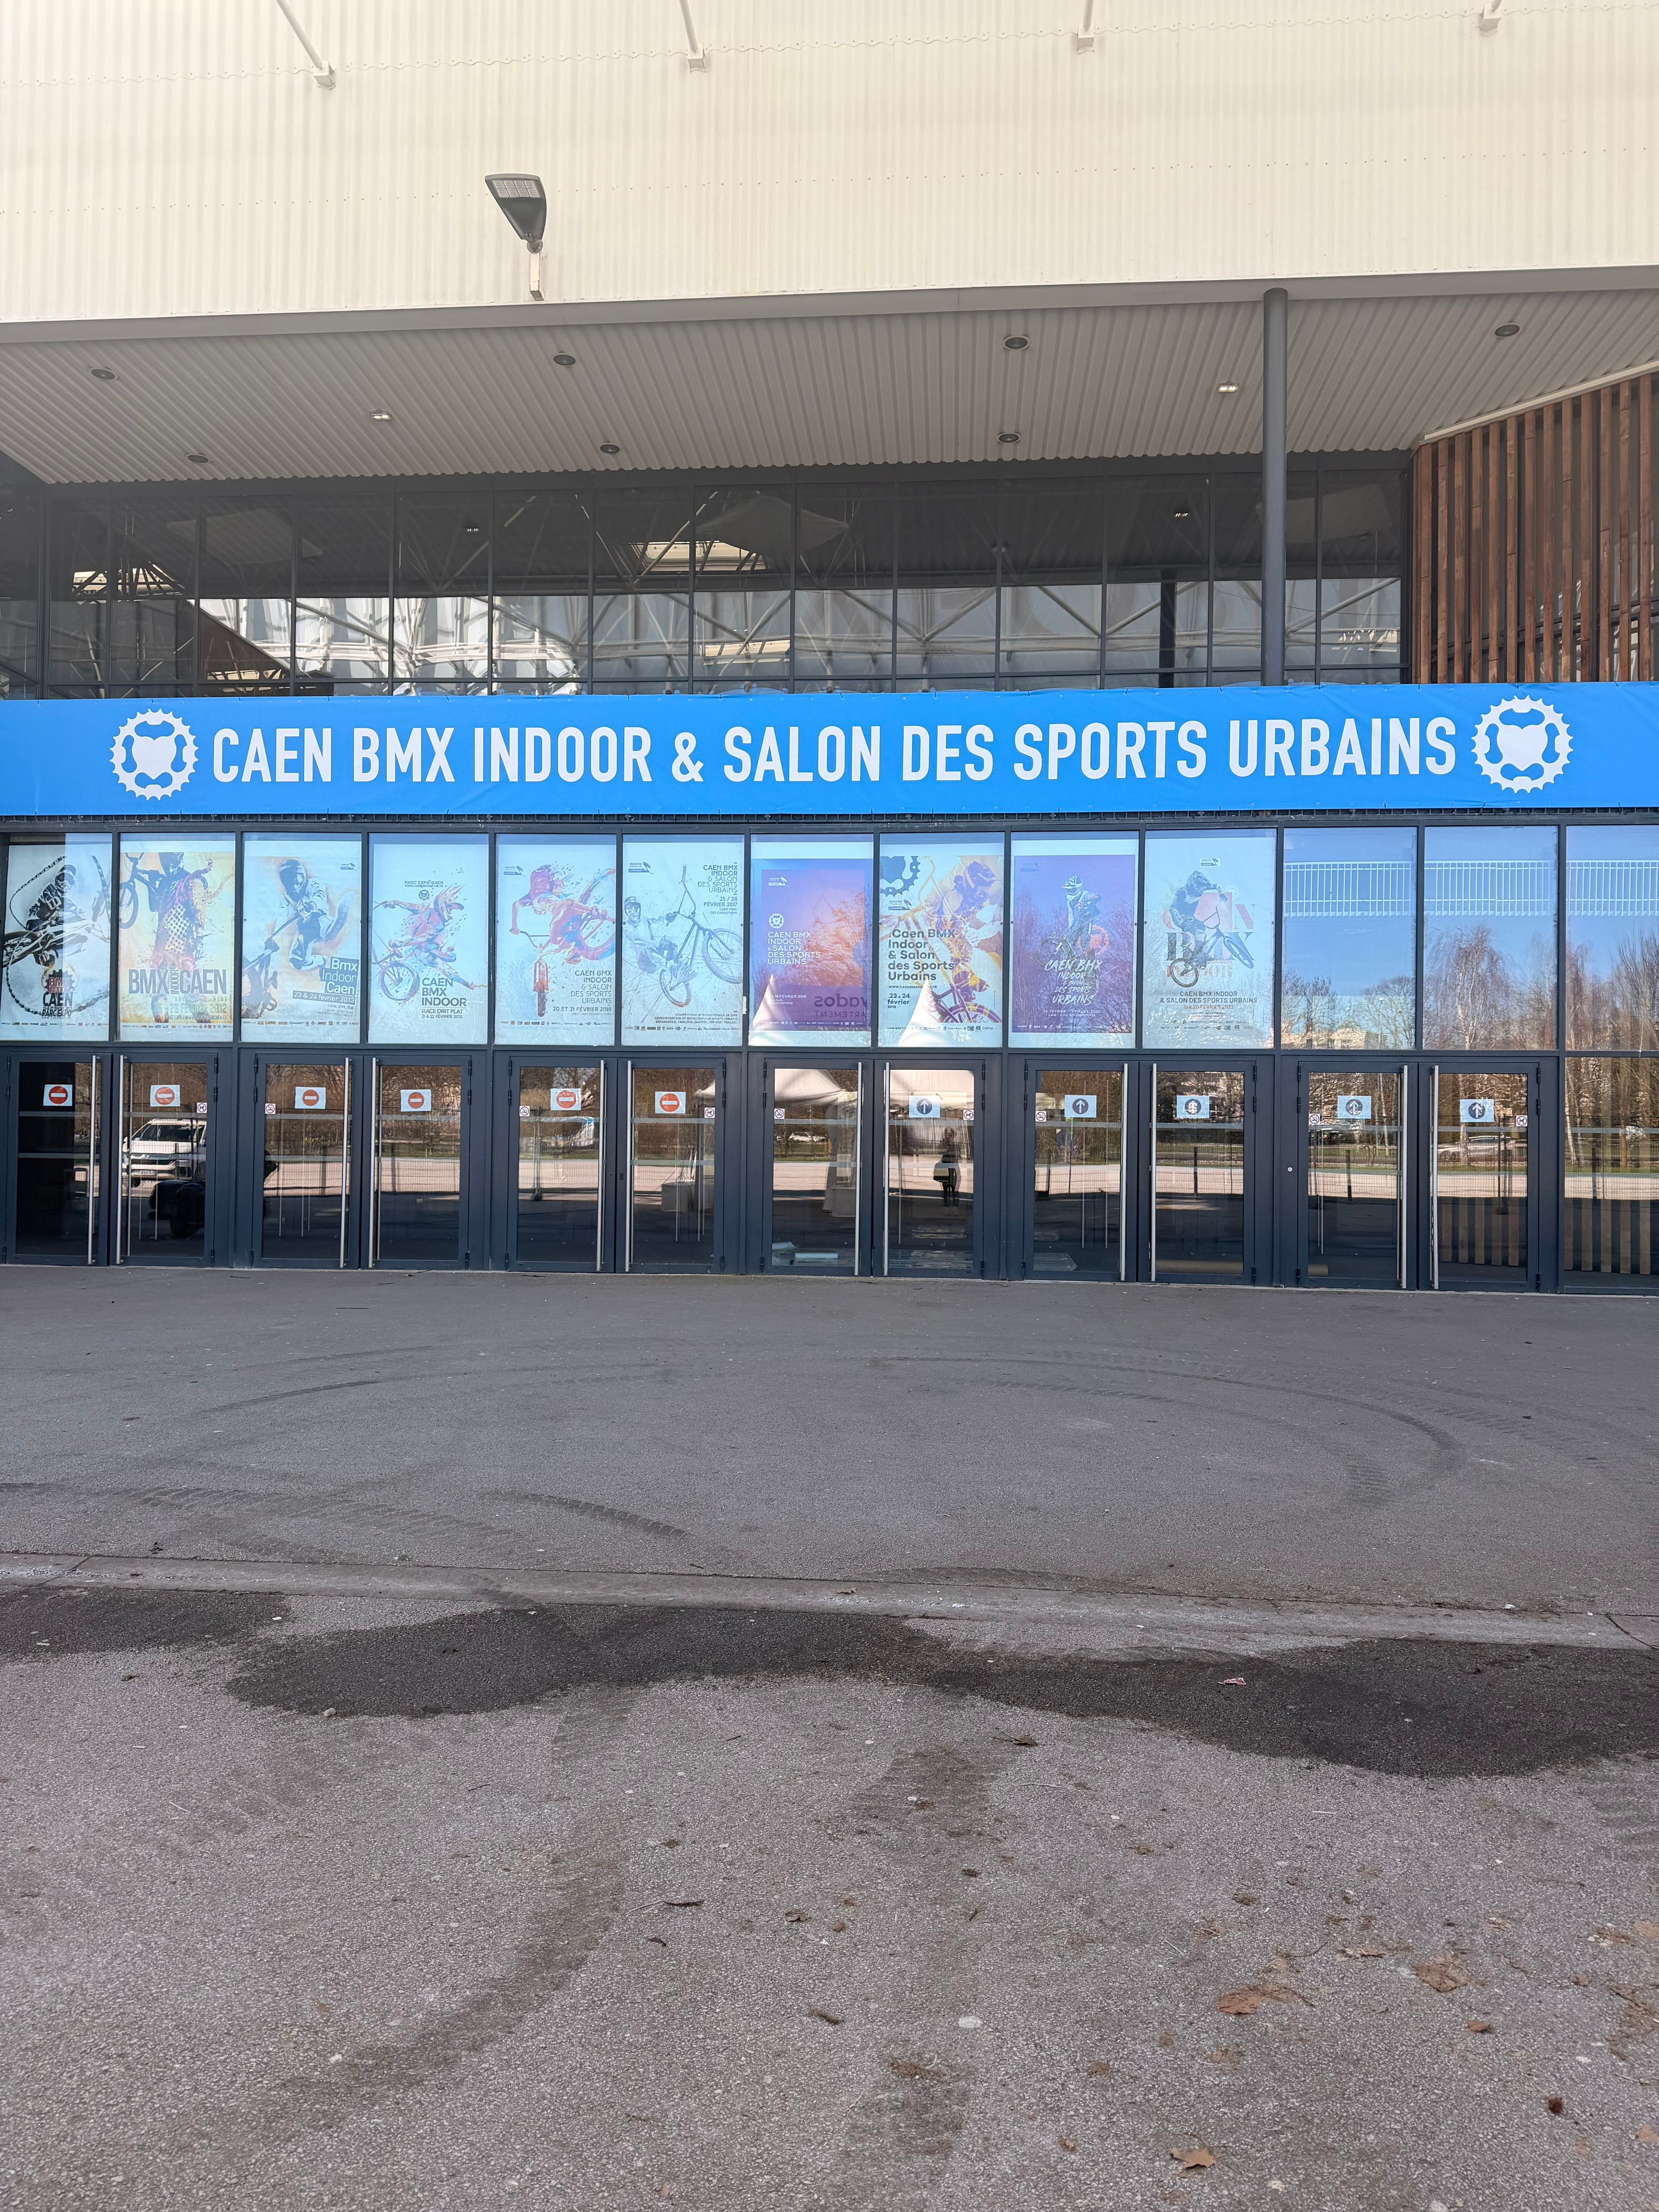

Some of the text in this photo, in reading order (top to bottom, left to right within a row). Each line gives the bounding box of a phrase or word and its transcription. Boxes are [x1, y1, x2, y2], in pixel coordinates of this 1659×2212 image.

[214, 717, 1456, 782] CAEN BMX INDOOR & SALON DES SPORTS URBAINS
[928, 929, 955, 938] BMX
[888, 939, 928, 949] Indoor
[888, 950, 935, 959] & Salon
[332, 959, 358, 971] Bmx
[888, 960, 954, 972] des Sports
[1044, 959, 1103, 973] CAEN BMX
[129, 969, 170, 994] BMX
[170, 967, 179, 994] INDOOR
[179, 969, 227, 994] CAEN
[322, 969, 357, 983] Indoor
[888, 971, 936, 980] Urbains
[1058, 972, 1086, 980] INDOOR
[327, 981, 355, 995] Caen
[422, 978, 453, 987] CAEN
[422, 988, 447, 996] BMX
[43, 991, 73, 1006] CAEN
[421, 997, 467, 1006] INDOOR
[1052, 994, 1094, 1006] URBAINS
